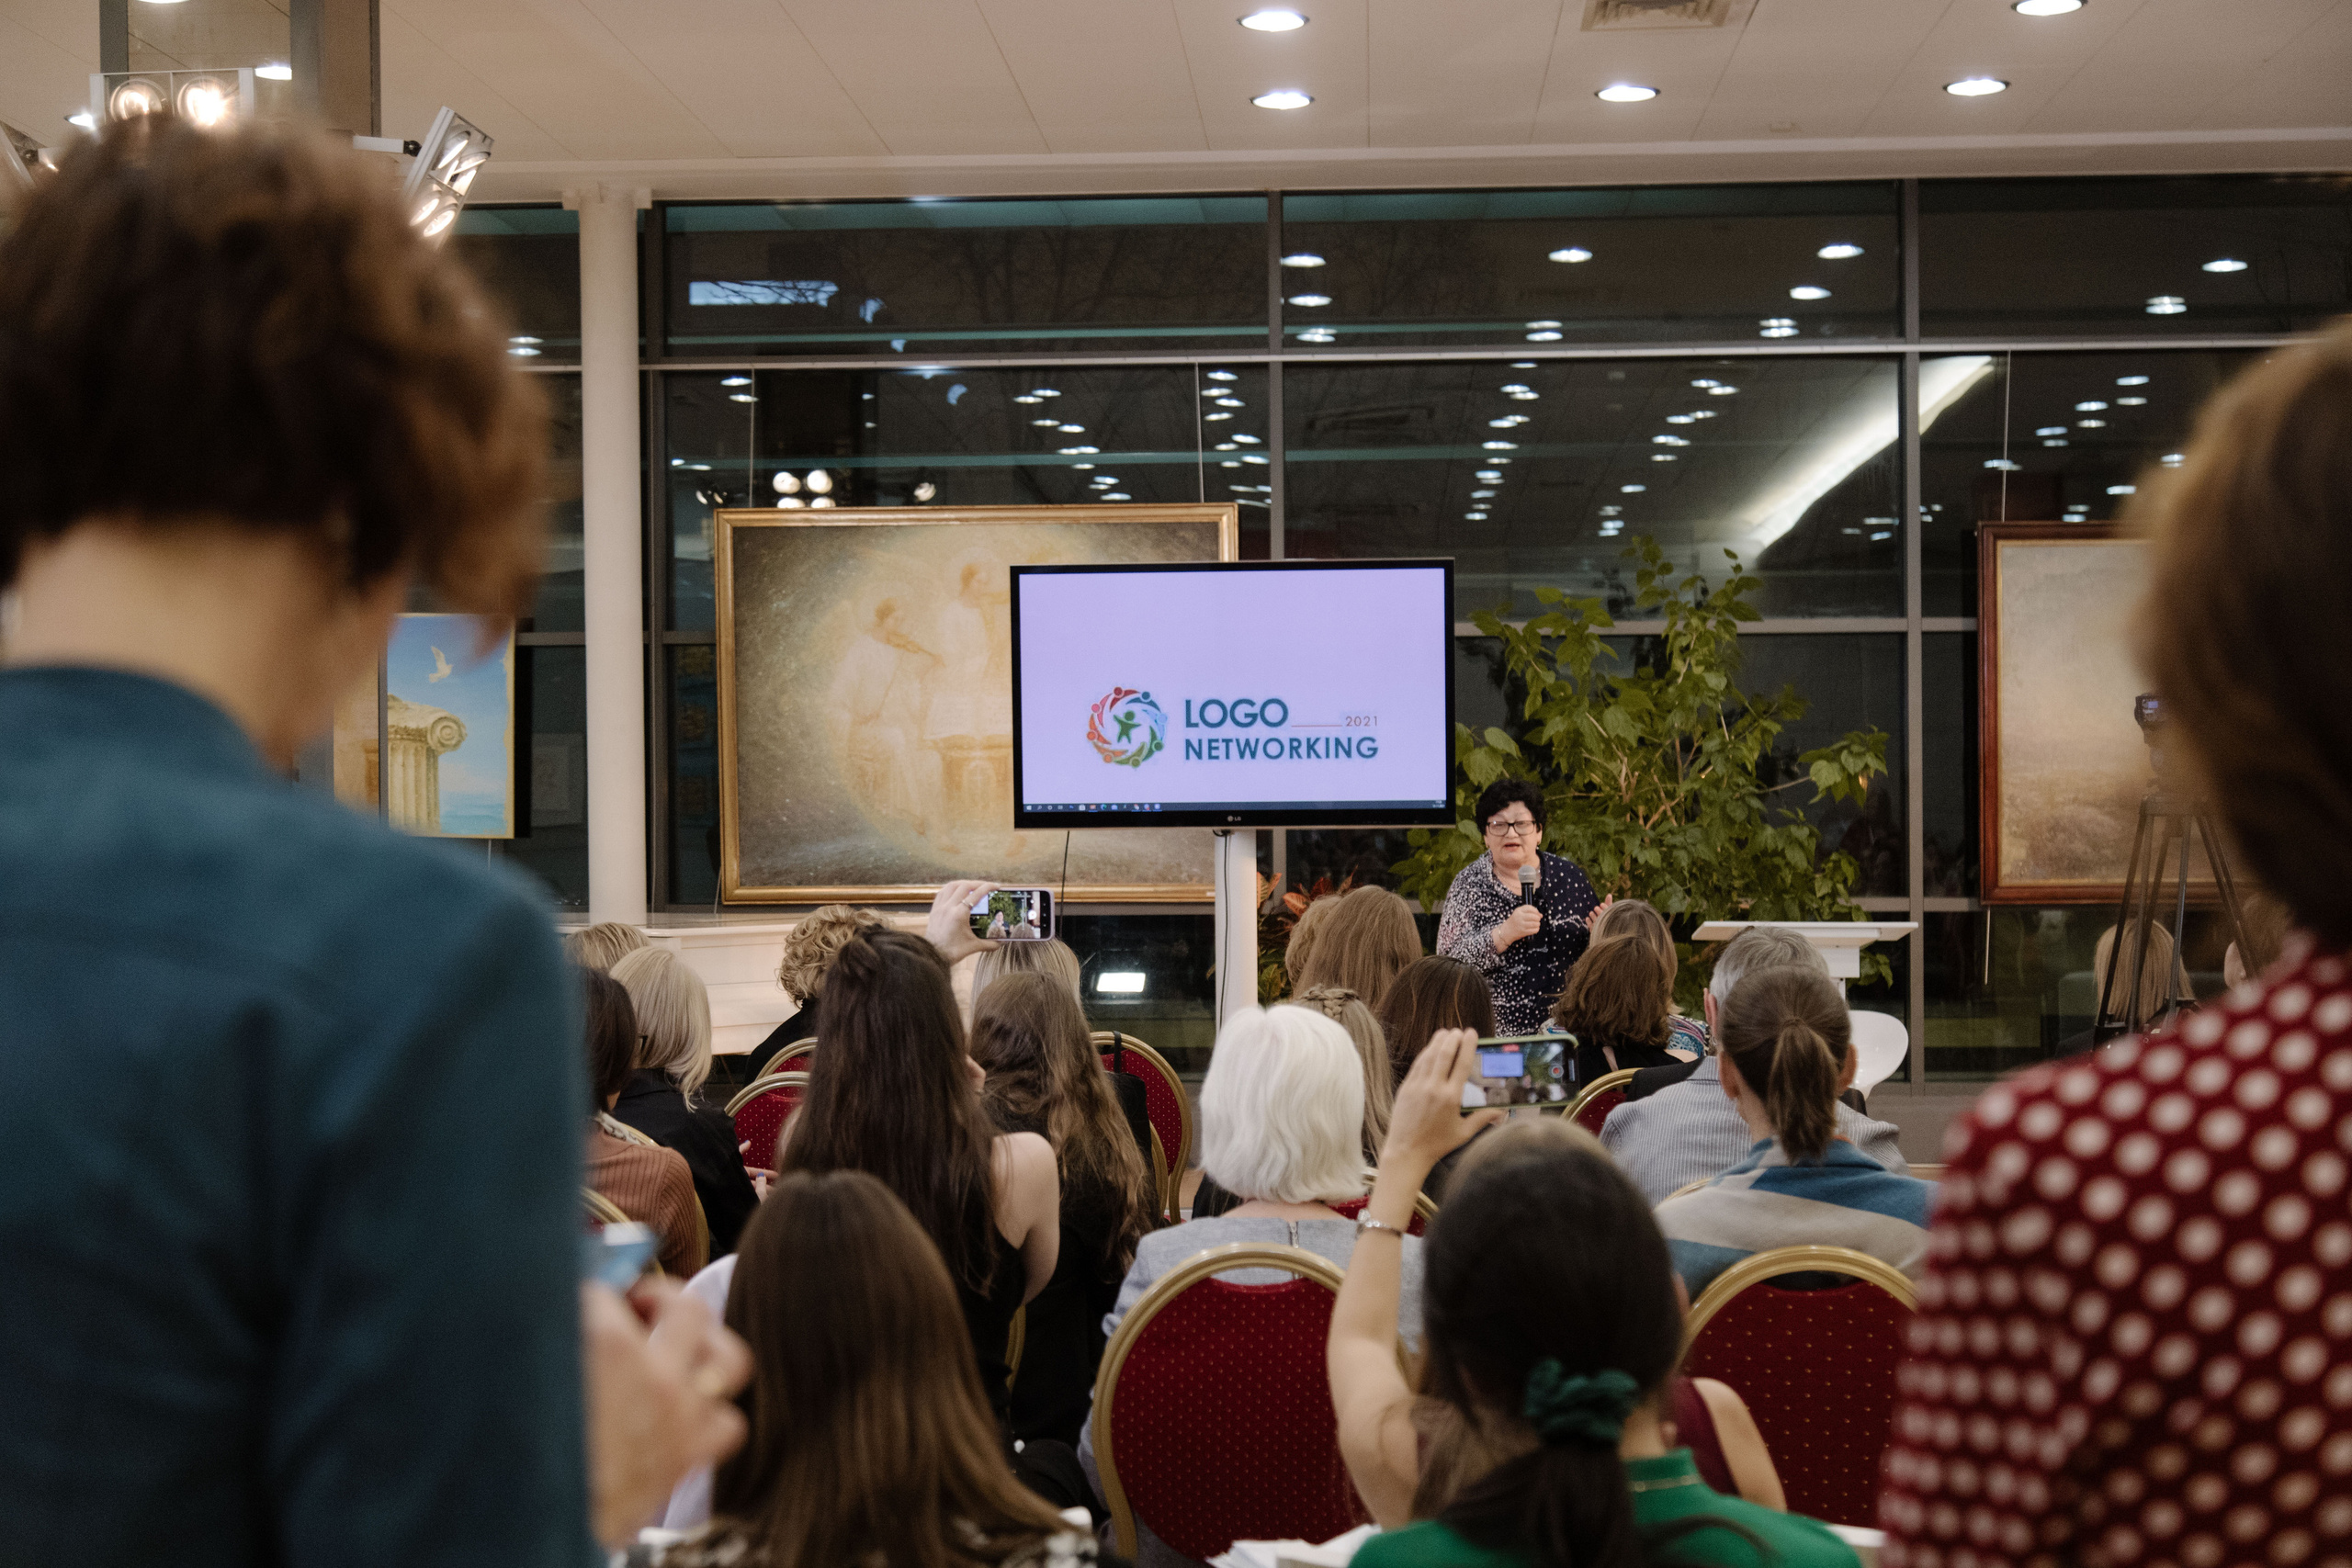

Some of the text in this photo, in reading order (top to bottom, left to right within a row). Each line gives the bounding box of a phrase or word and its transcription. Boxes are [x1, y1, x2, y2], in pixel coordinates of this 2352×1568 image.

[1185, 698, 1289, 728] LOGO
[1345, 716, 1378, 727] 2021
[1185, 737, 1379, 761] NETWORKING
